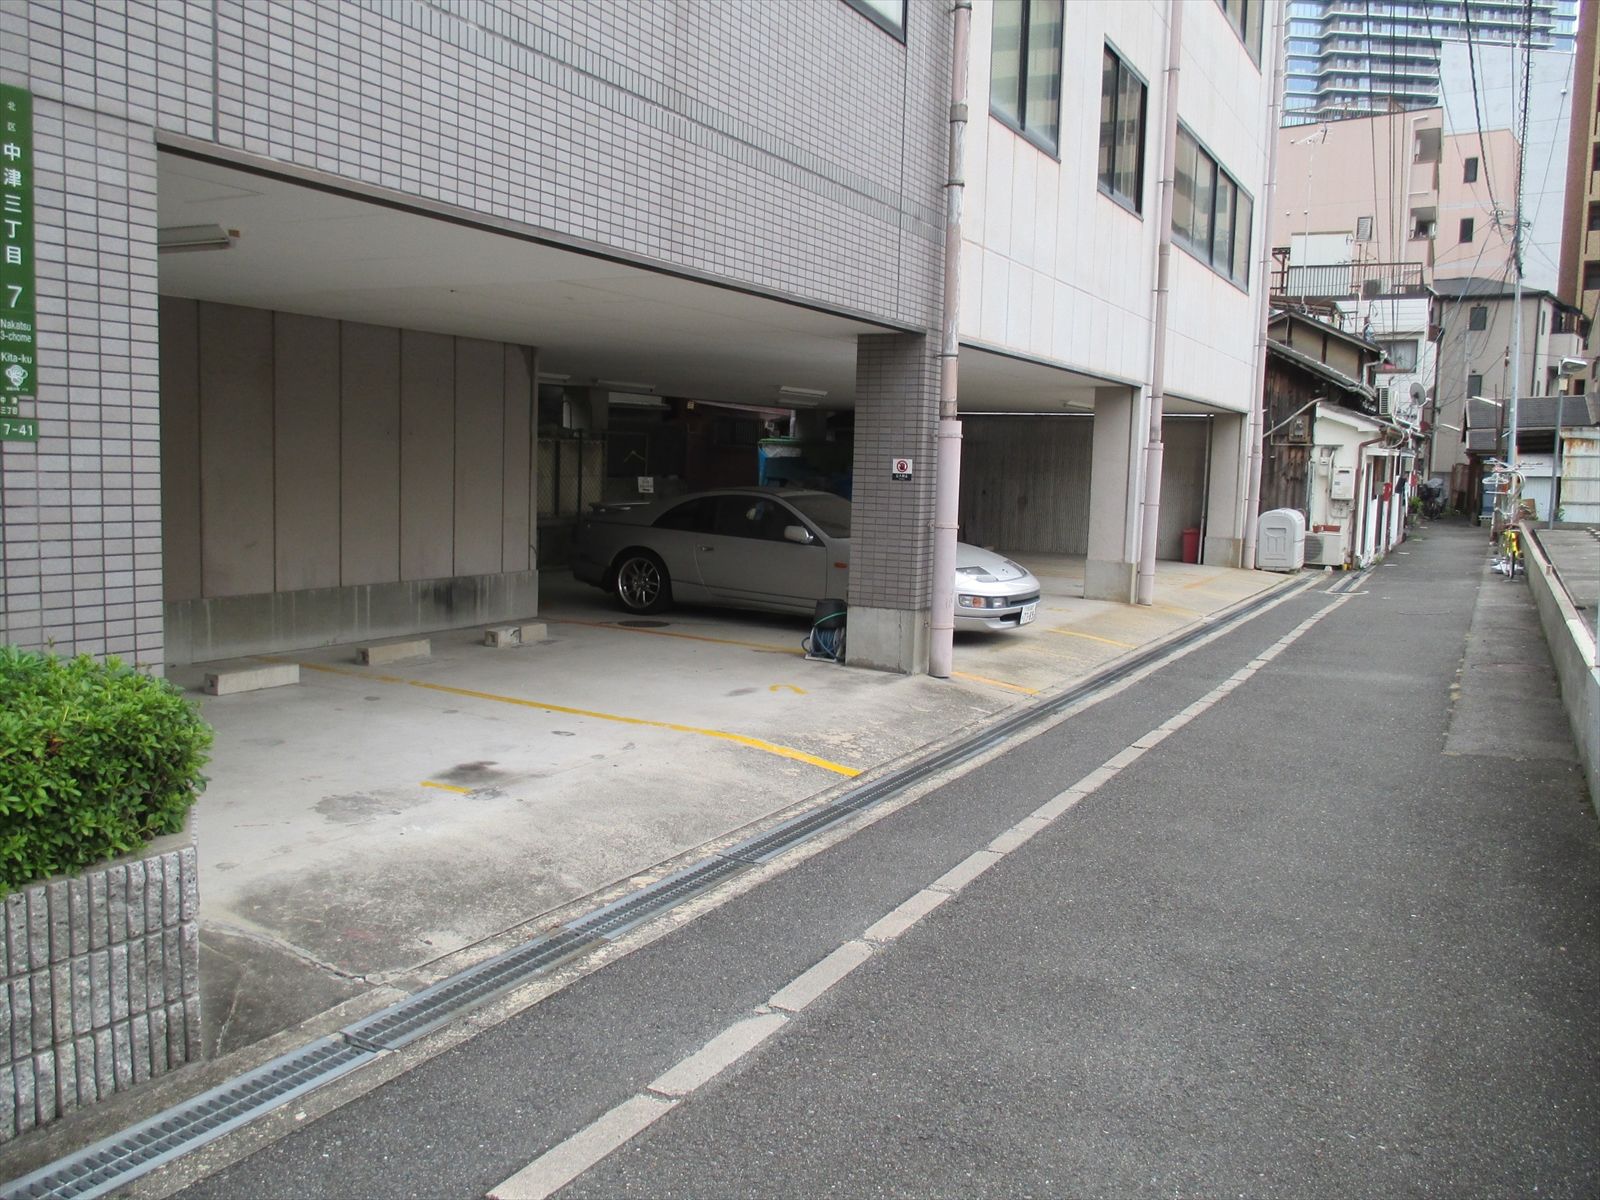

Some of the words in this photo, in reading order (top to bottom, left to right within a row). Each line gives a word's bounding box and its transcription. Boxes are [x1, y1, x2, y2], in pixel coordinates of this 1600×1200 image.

[4, 143, 22, 265] 中津三丁目
[7, 284, 22, 308] 7
[0, 319, 31, 332] Nakatsu
[0, 330, 32, 343] 3-chome
[1, 352, 33, 364] Kita-ku
[3, 423, 33, 436] 7-41
